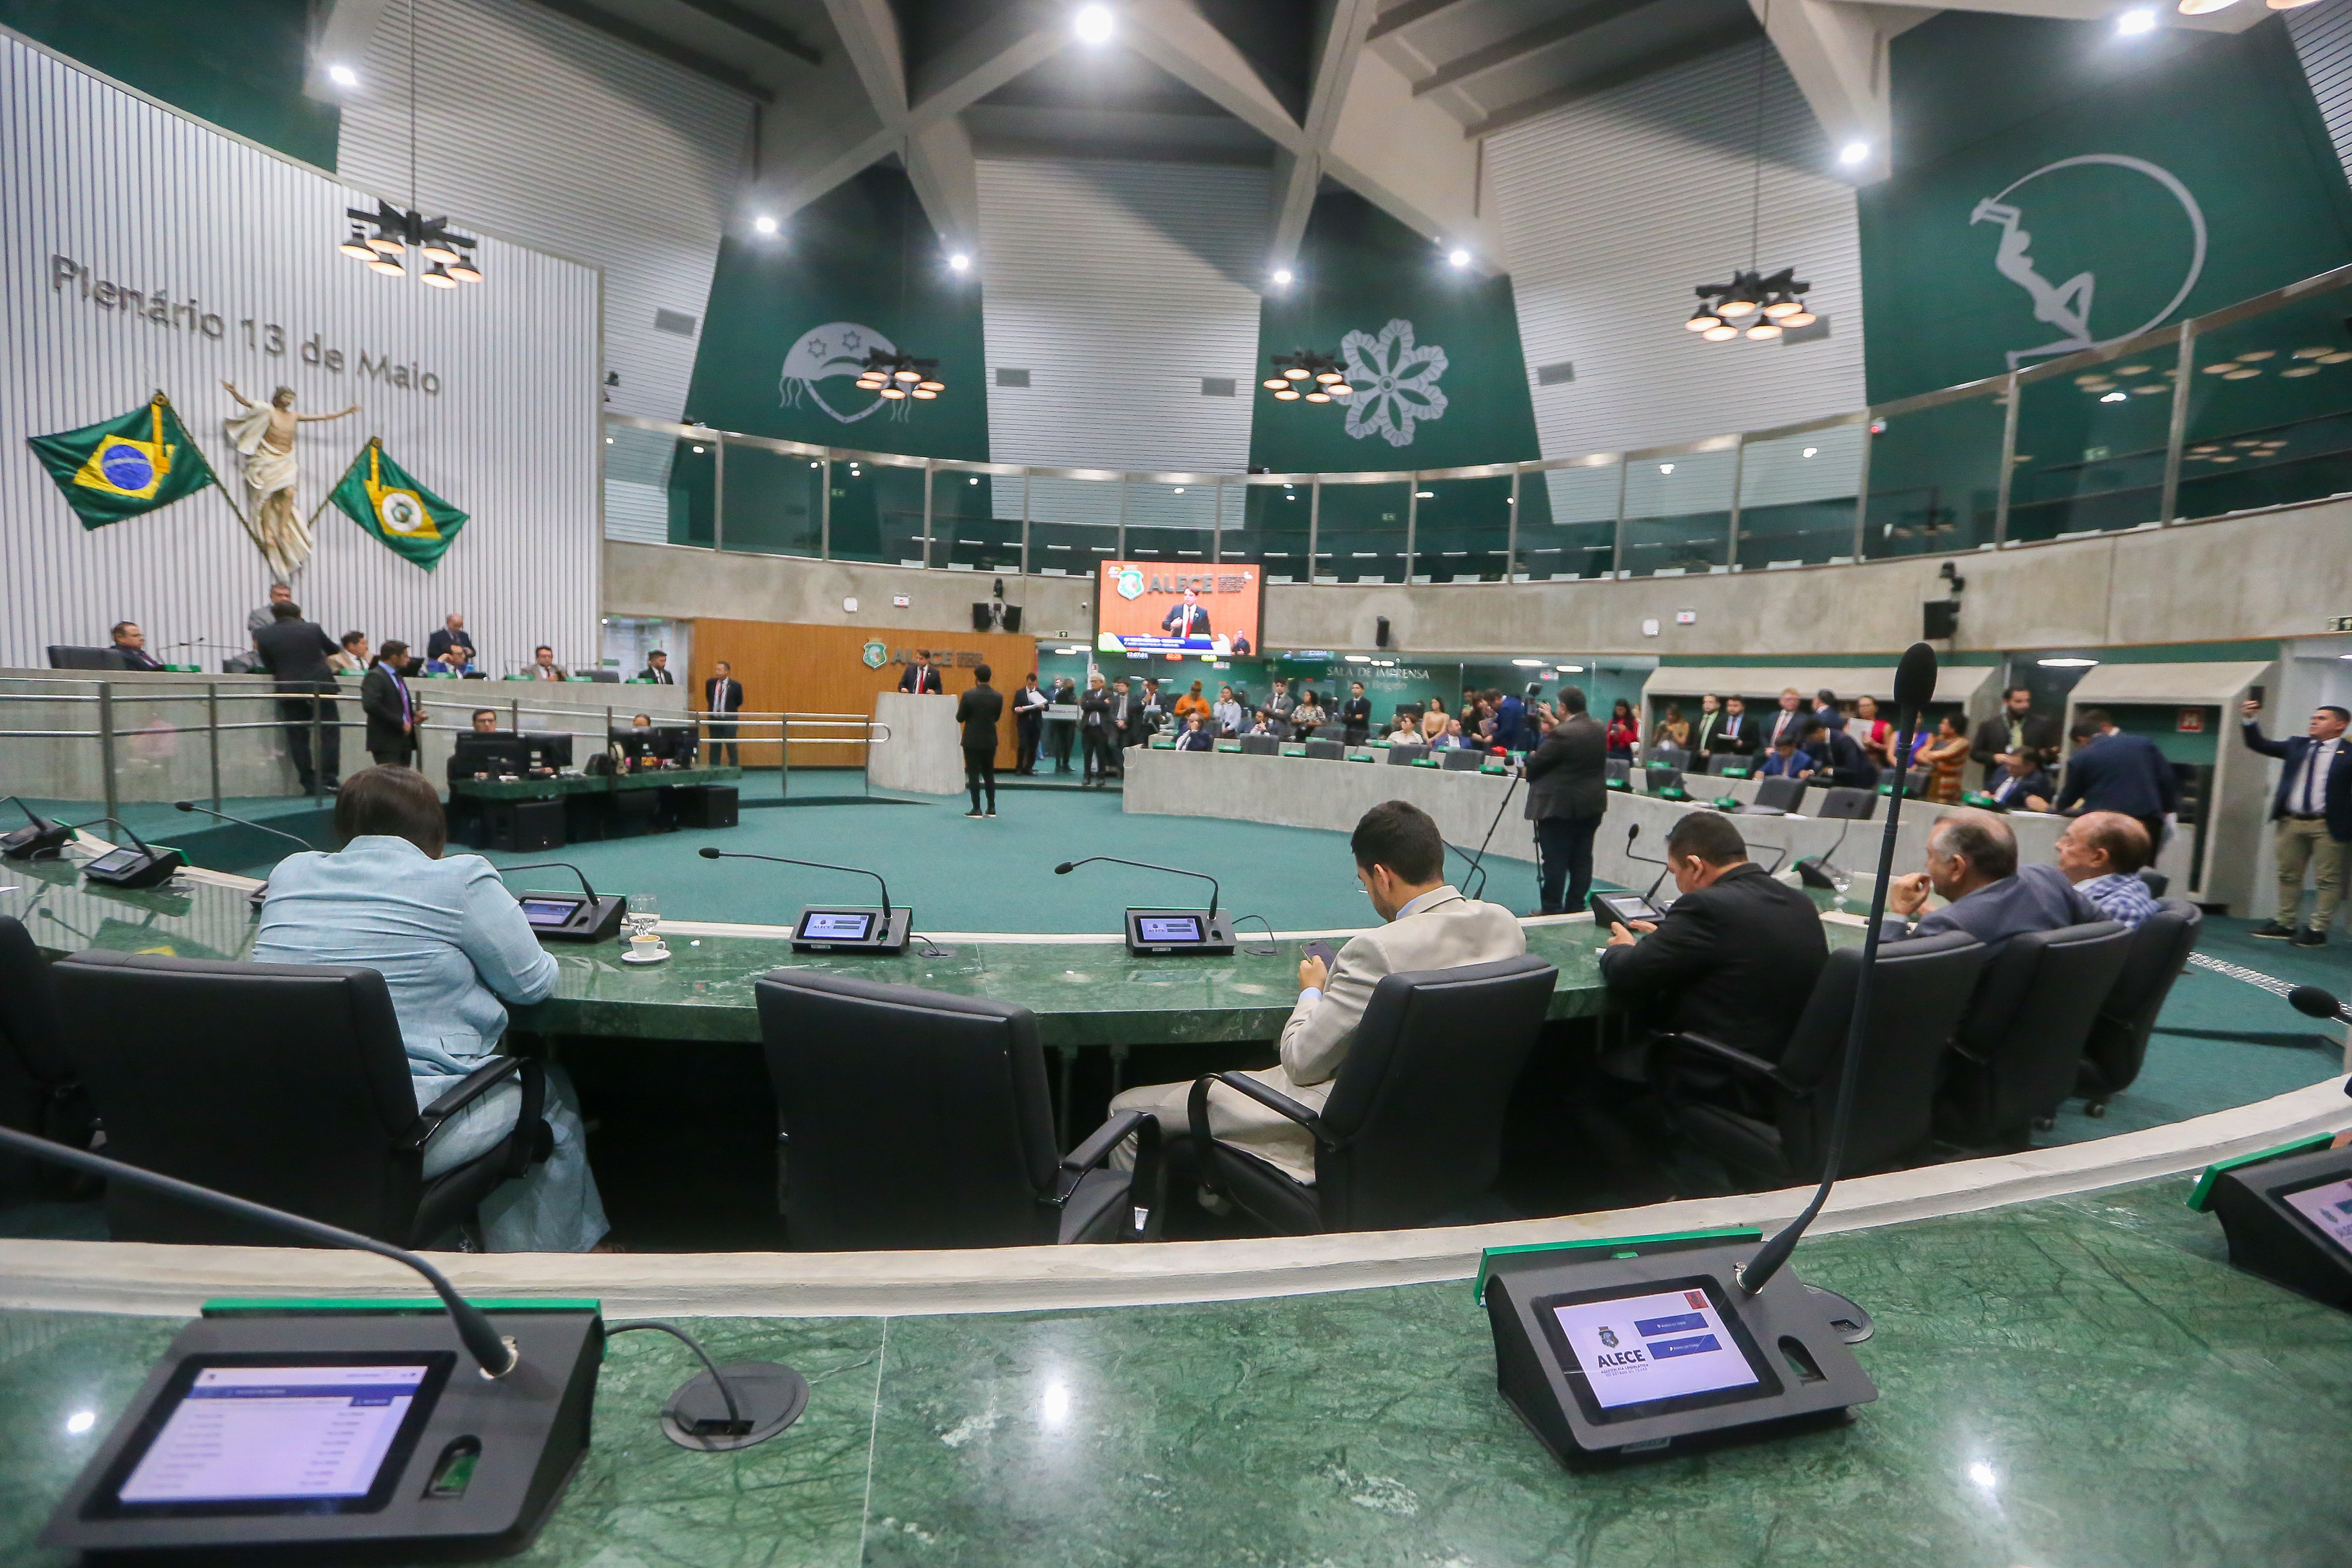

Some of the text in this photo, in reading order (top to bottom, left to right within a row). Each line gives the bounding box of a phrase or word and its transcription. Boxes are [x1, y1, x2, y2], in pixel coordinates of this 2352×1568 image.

[52, 253, 440, 397] Plenário 13 de Maio
[1148, 573, 1213, 594] ALECE
[890, 649, 953, 667] ALCE
[1326, 665, 1430, 680] SALA DE IMPRENSA
[1598, 1349, 1646, 1367] ALECE
